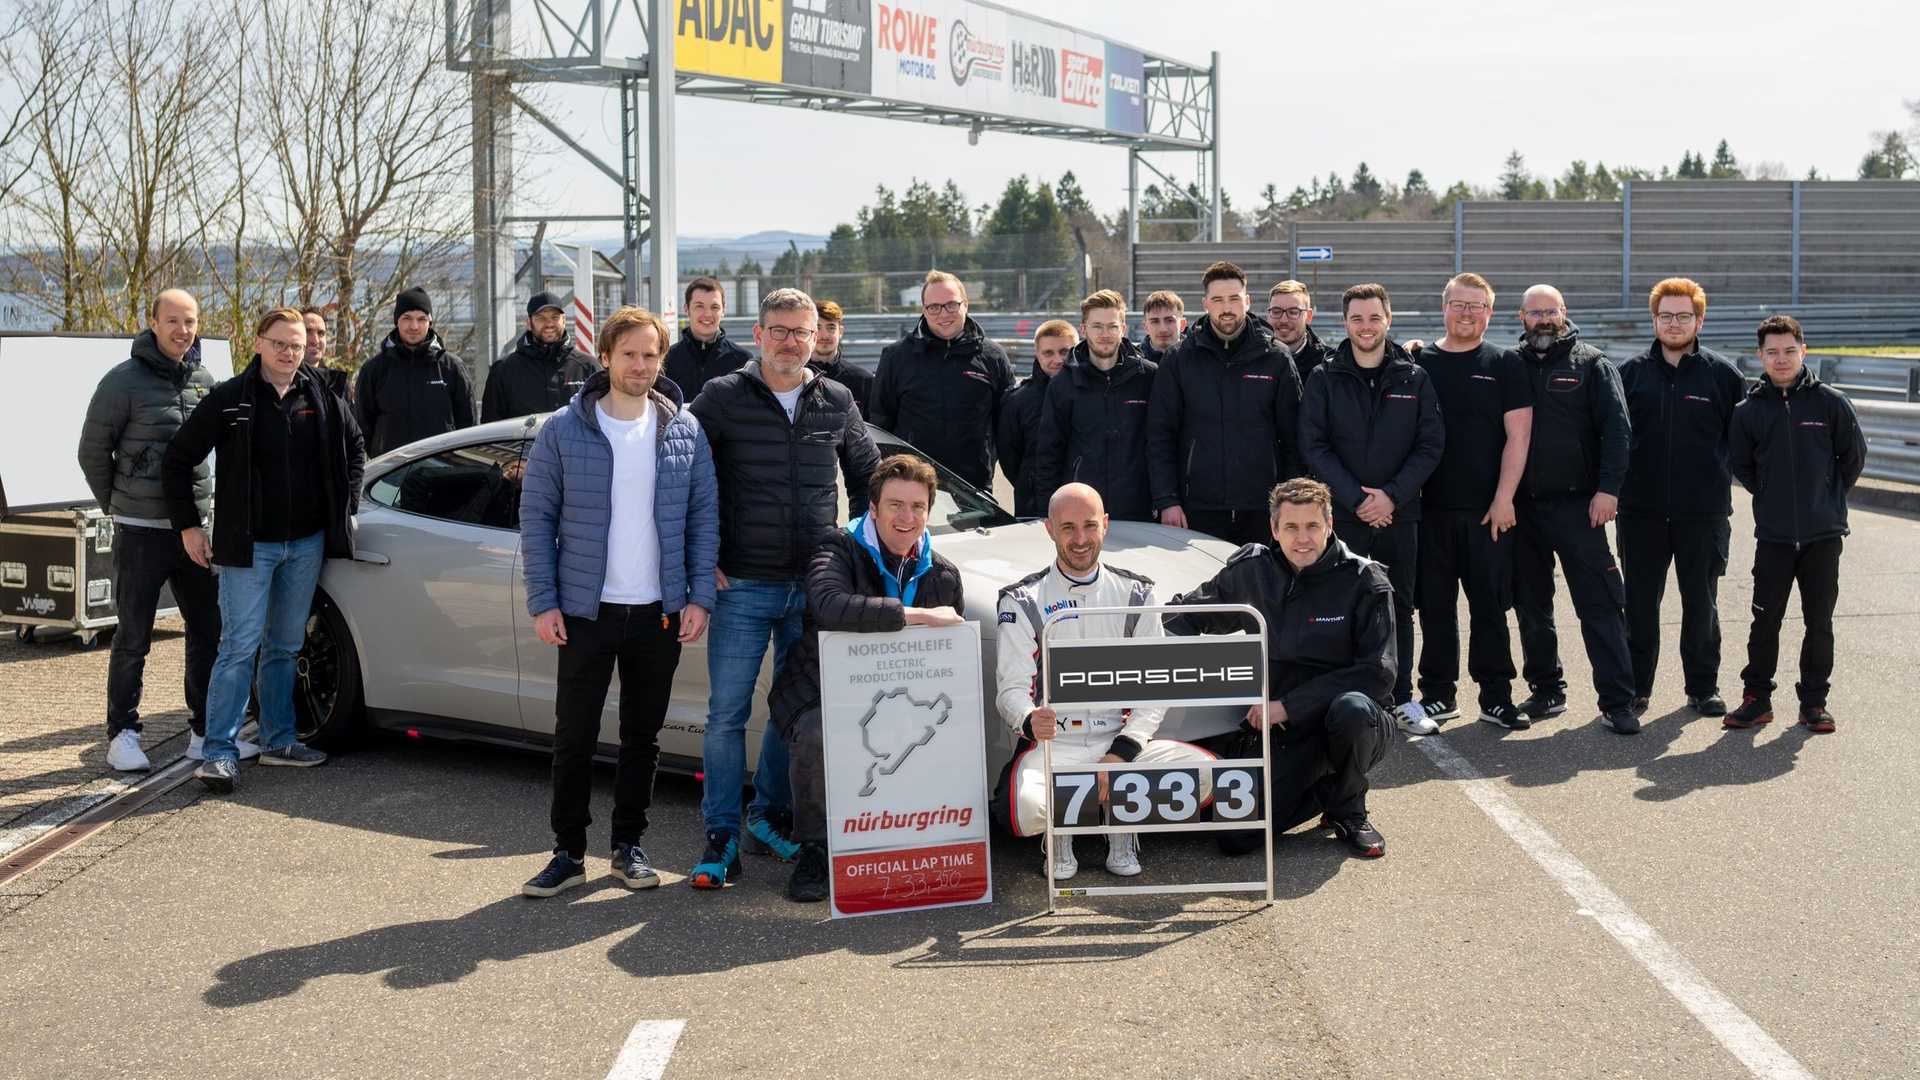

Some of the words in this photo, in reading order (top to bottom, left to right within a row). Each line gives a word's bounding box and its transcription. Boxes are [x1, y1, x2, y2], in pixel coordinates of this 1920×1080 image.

[790, 12, 819, 43] GRAN
[820, 18, 863, 51] TURISMO
[878, 4, 937, 59] ROWE
[900, 59, 925, 78] MOTOR
[926, 63, 937, 80] OIL
[1044, 600, 1068, 616] Mobil
[1315, 615, 1345, 623] MANTHEY
[848, 639, 953, 657] NORDSCHLEIFE
[876, 658, 927, 671] ELECTRIC
[849, 671, 923, 684] PRODUCTION
[926, 667, 954, 679] CARS
[1059, 666, 1254, 687] PORSCHE
[1055, 774, 1096, 825] 7
[1216, 769, 1256, 819] 3
[843, 805, 973, 833] nürburgring
[846, 860, 909, 877] OFFICIAL
[913, 857, 938, 870] LAP
[940, 853, 974, 867] TIME
